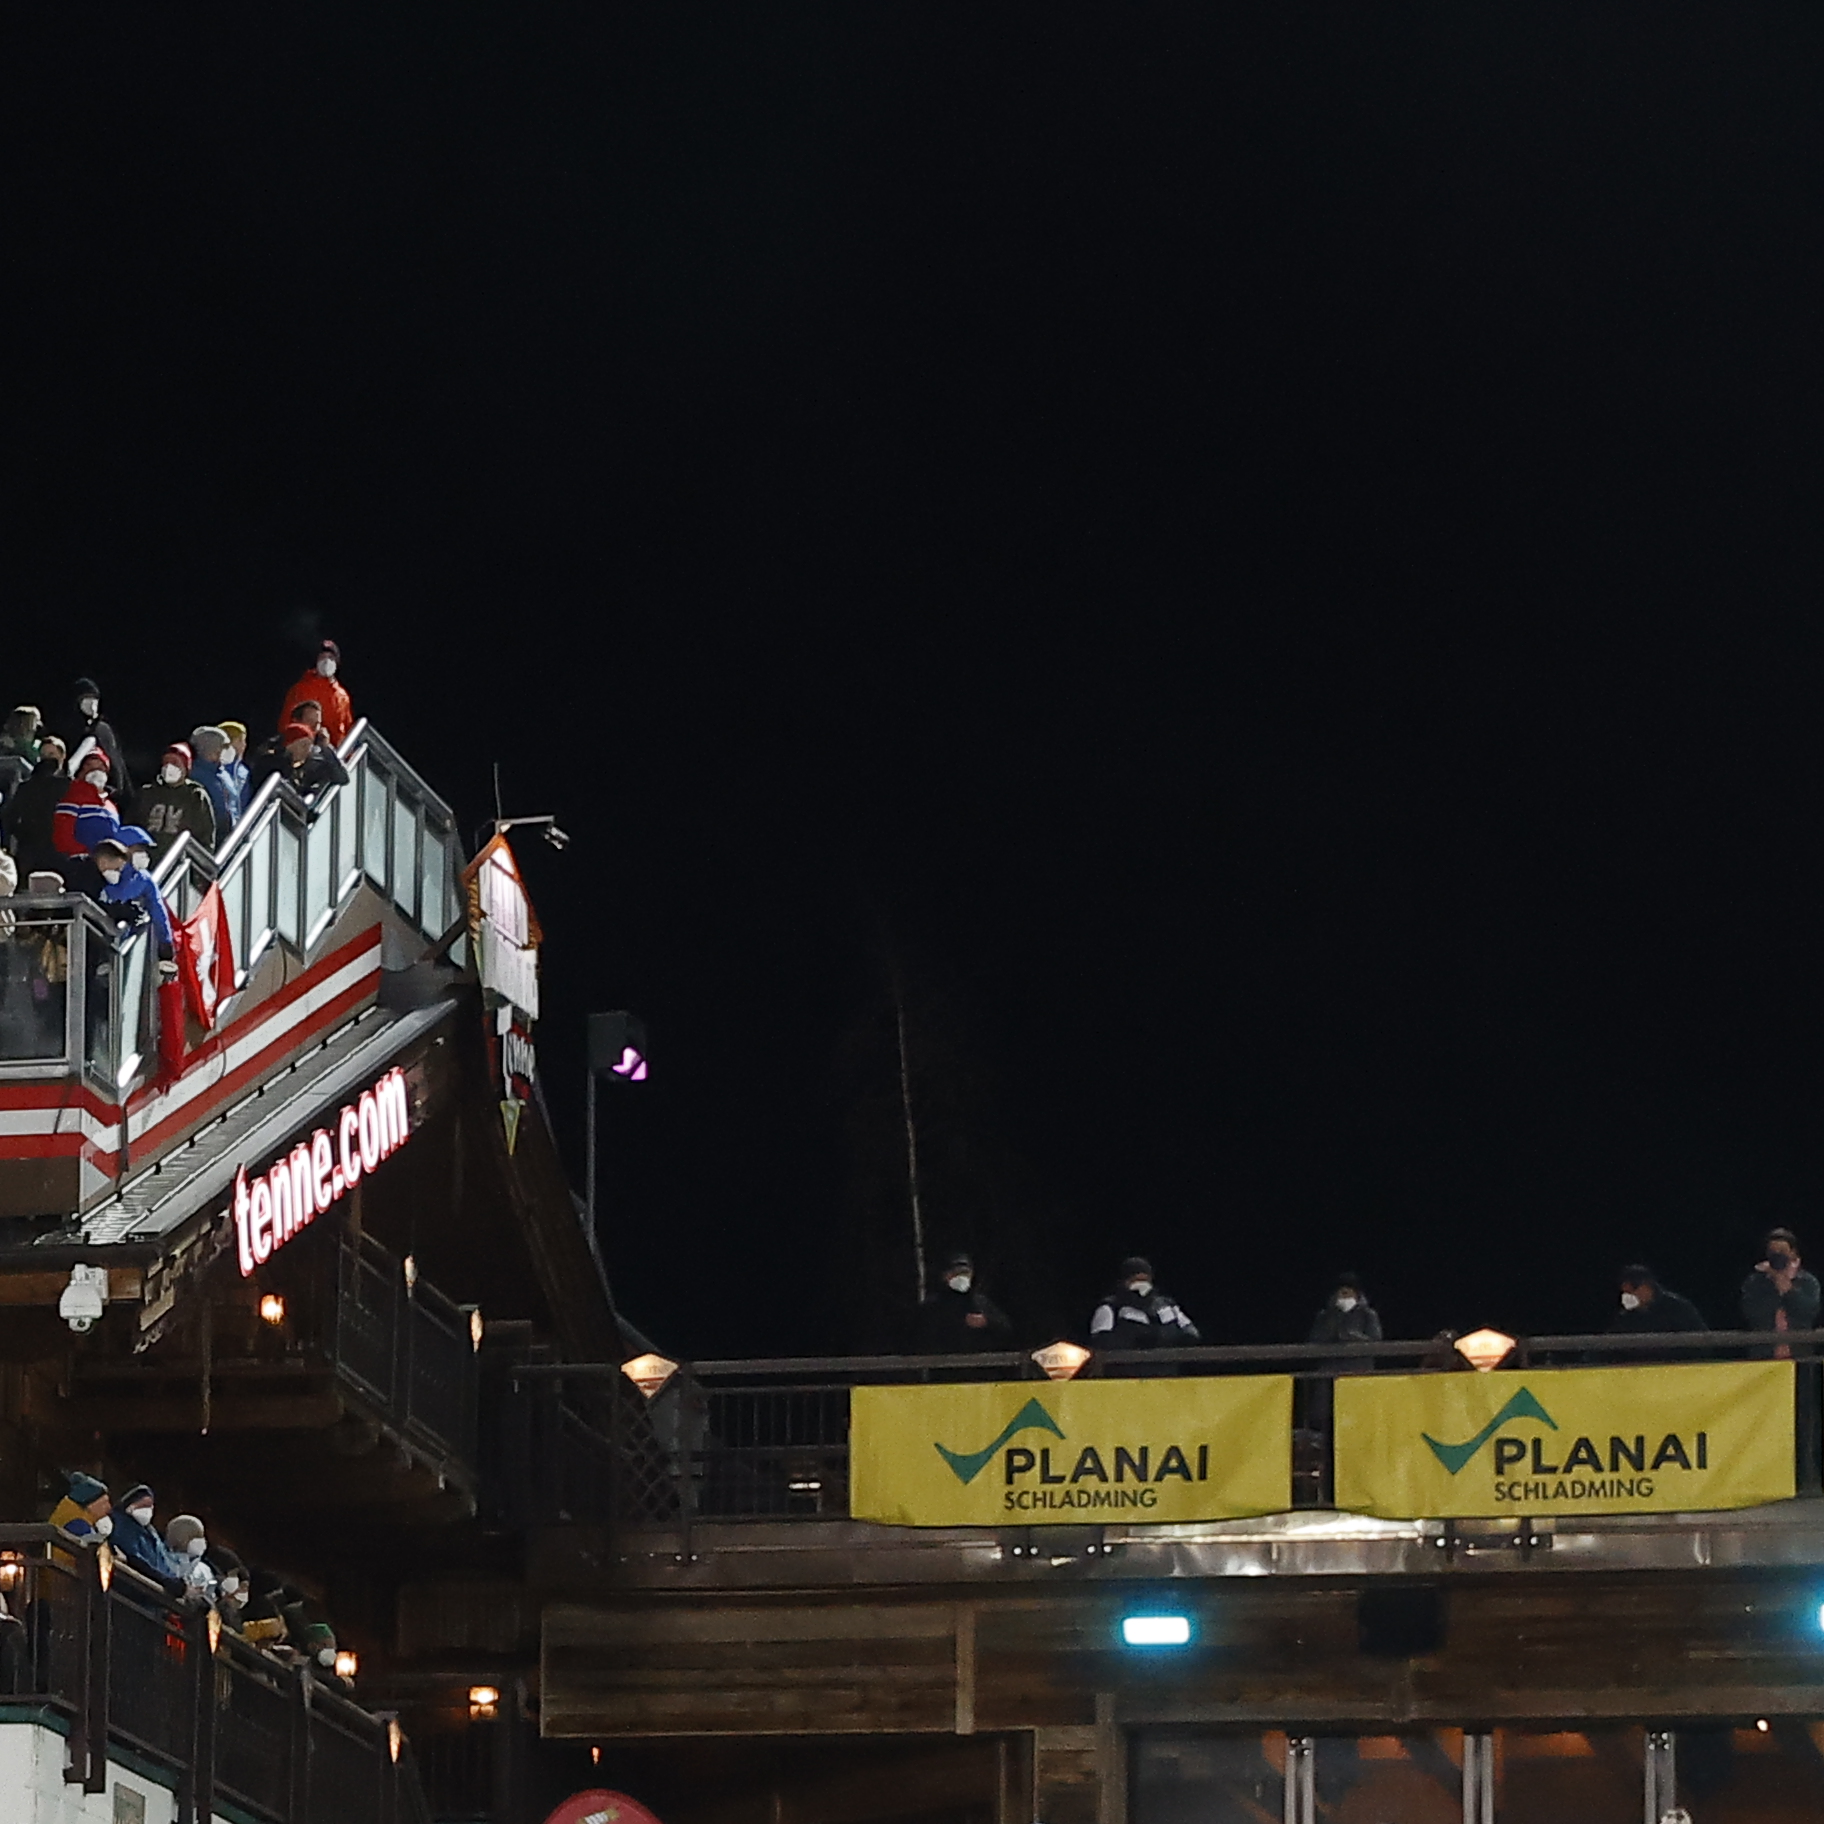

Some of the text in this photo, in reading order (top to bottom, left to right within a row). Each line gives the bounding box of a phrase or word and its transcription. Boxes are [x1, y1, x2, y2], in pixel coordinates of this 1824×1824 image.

[233, 1065, 408, 1277] tenne.com
[1005, 1444, 1210, 1486] PLANAI
[1494, 1432, 1708, 1475] PLANAI
[1003, 1488, 1157, 1511] SCHLADMING
[1494, 1477, 1655, 1503] SCHLADMING
